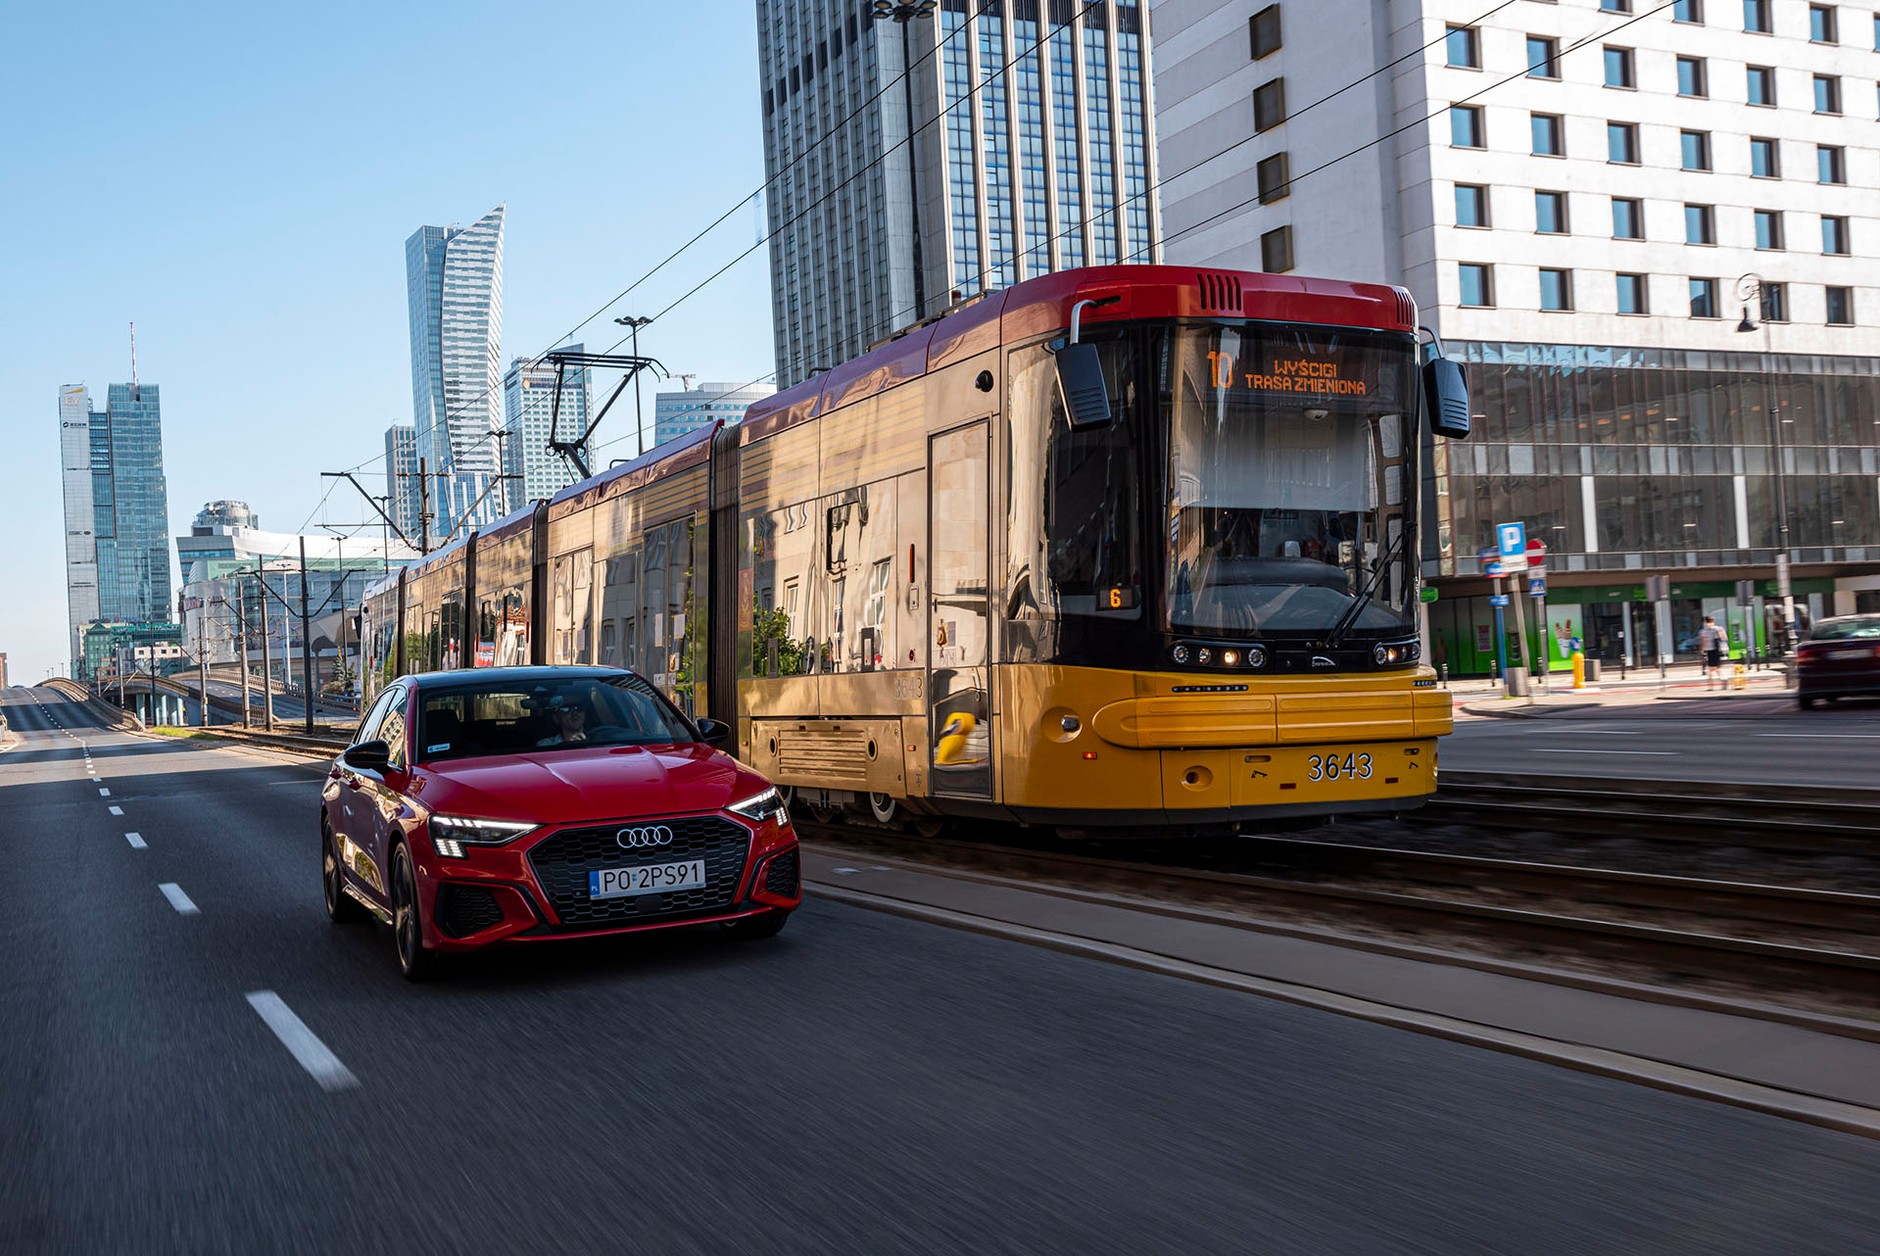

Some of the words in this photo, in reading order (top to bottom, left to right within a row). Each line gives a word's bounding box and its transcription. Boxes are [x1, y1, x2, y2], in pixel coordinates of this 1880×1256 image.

[1206, 351, 1233, 388] 10
[1274, 359, 1337, 378] WYŚCIGI
[1245, 374, 1293, 391] TRASA
[1294, 377, 1367, 395] ZMIENIONA
[1502, 527, 1520, 552] P
[1110, 588, 1121, 608] 6
[1308, 752, 1373, 782] 3643
[603, 870, 631, 892] PO
[638, 862, 699, 888] 2PS91
